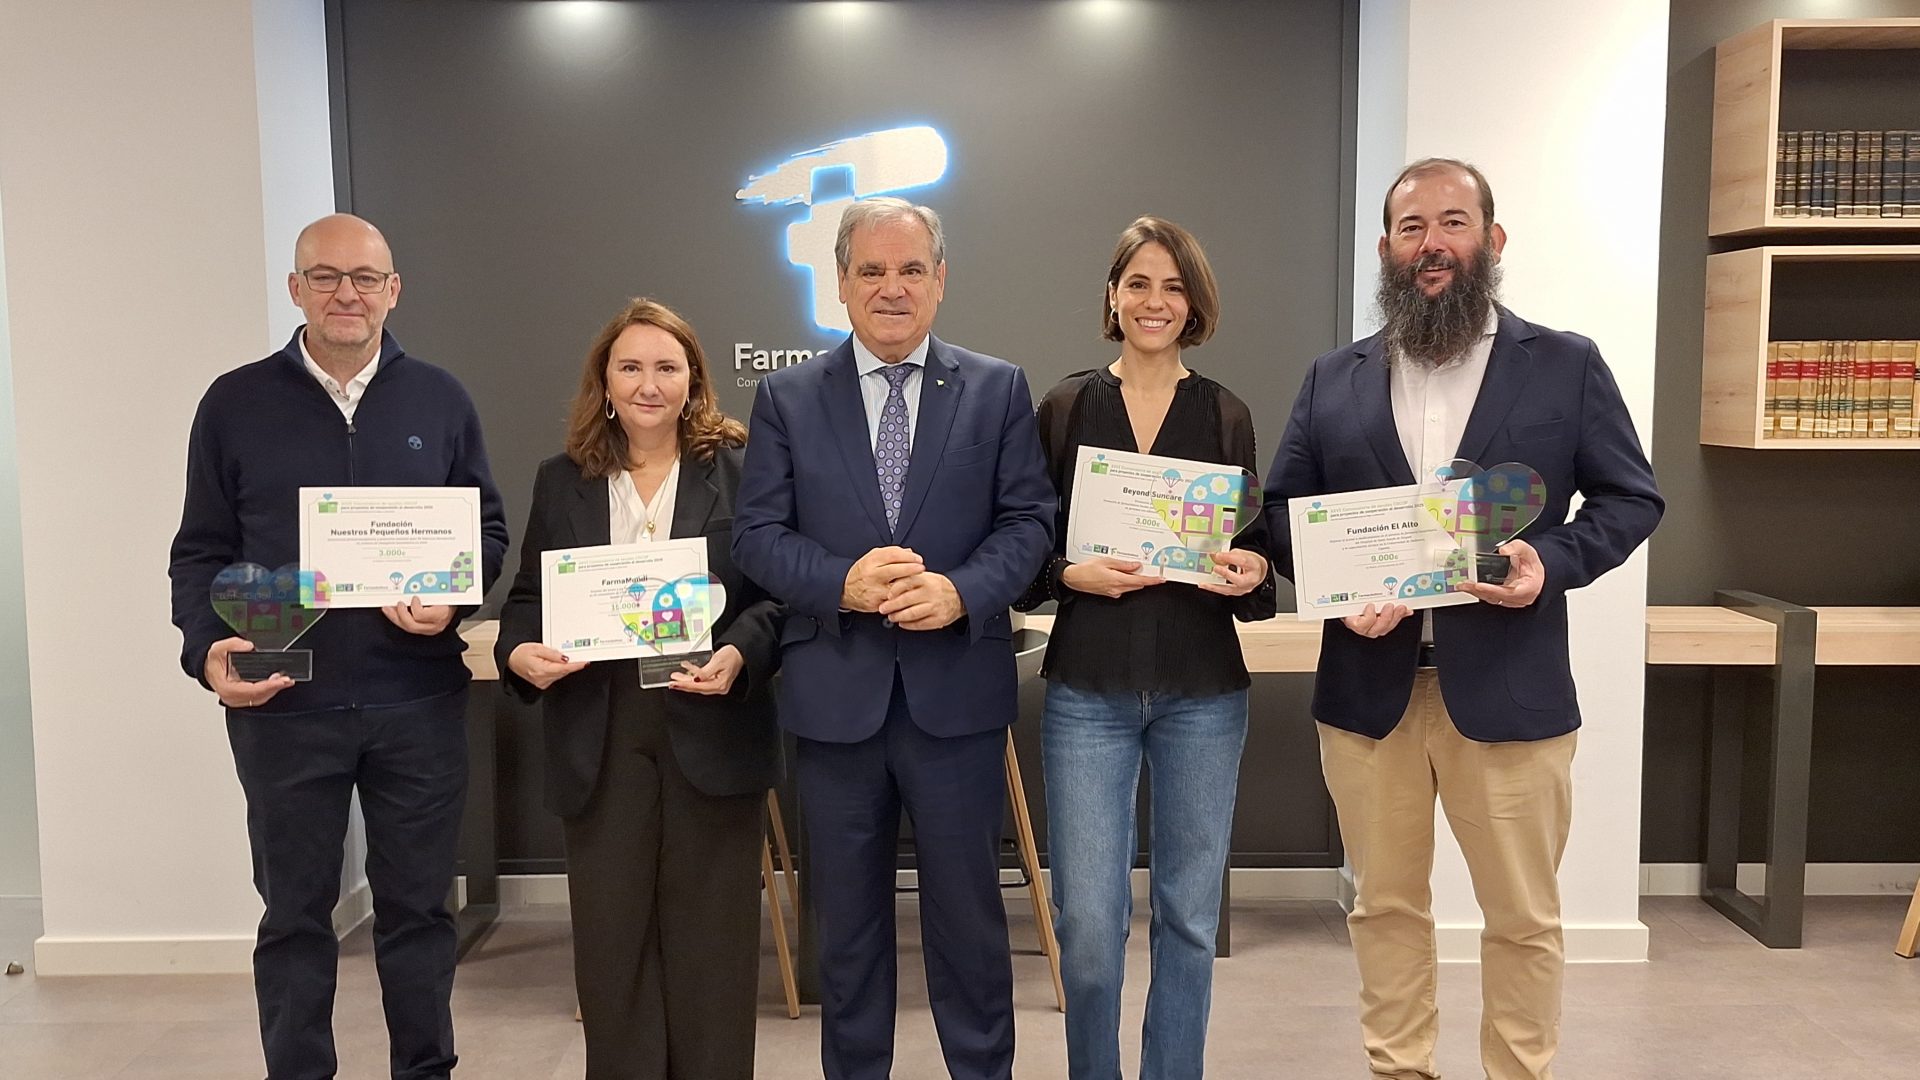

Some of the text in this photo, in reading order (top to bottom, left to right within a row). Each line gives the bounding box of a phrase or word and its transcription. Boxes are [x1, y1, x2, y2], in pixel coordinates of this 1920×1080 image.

[734, 343, 829, 370] Farm
[1122, 486, 1183, 502] Beyond Suncare
[371, 520, 413, 528] Fundación
[1346, 520, 1419, 535] Fundación El Alto
[330, 527, 452, 537] Nuestros Pequeños Hermanos
